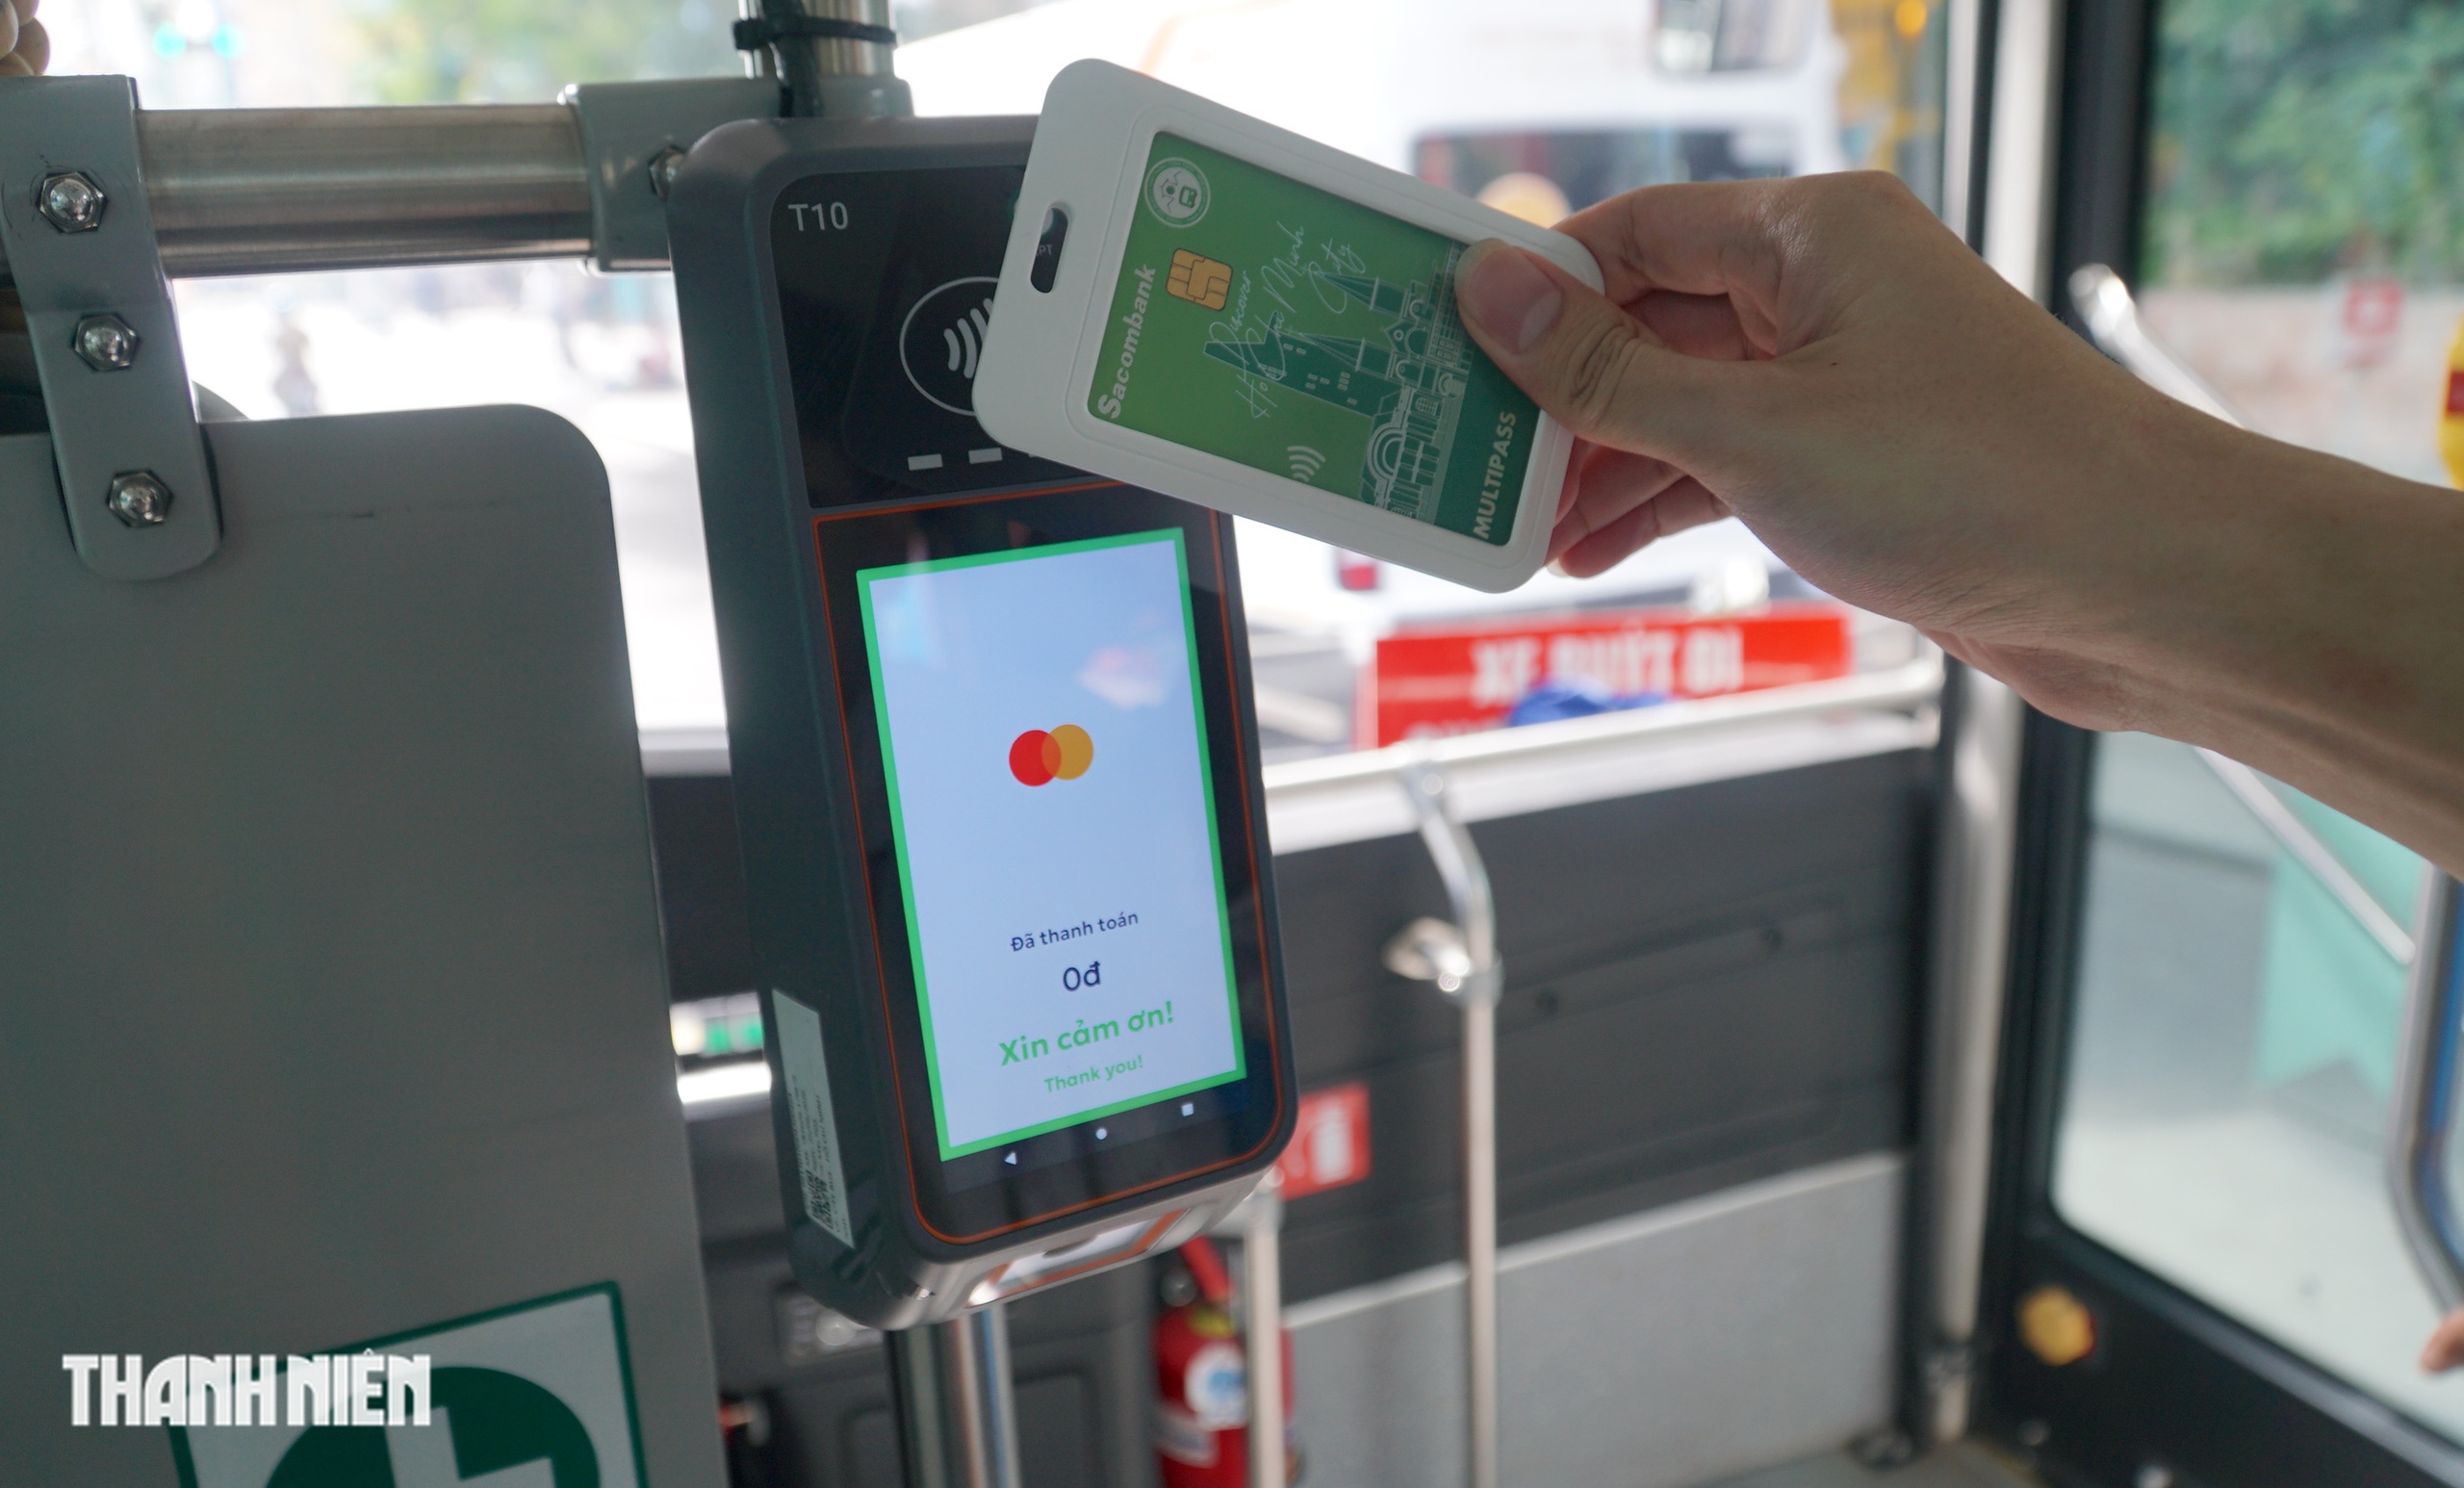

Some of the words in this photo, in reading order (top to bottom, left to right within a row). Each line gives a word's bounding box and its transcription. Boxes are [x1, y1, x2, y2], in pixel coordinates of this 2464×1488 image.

[788, 201, 849, 231] T10
[1262, 220, 1304, 314] Minh
[1308, 238, 1366, 314] City
[1097, 264, 1156, 420] Sacombank
[1209, 269, 1252, 382] Discover
[1474, 411, 1517, 540] MULTIPASS
[1011, 933, 1036, 952] Đã
[1040, 921, 1093, 945] thanh
[1098, 911, 1139, 932] toán
[1063, 961, 1101, 991] 0đ
[999, 1035, 1049, 1066] Xin
[1057, 1019, 1120, 1051] cảm
[1127, 1000, 1174, 1033] ơn!
[1043, 1066, 1101, 1093] Thank
[1104, 1054, 1143, 1081] you!
